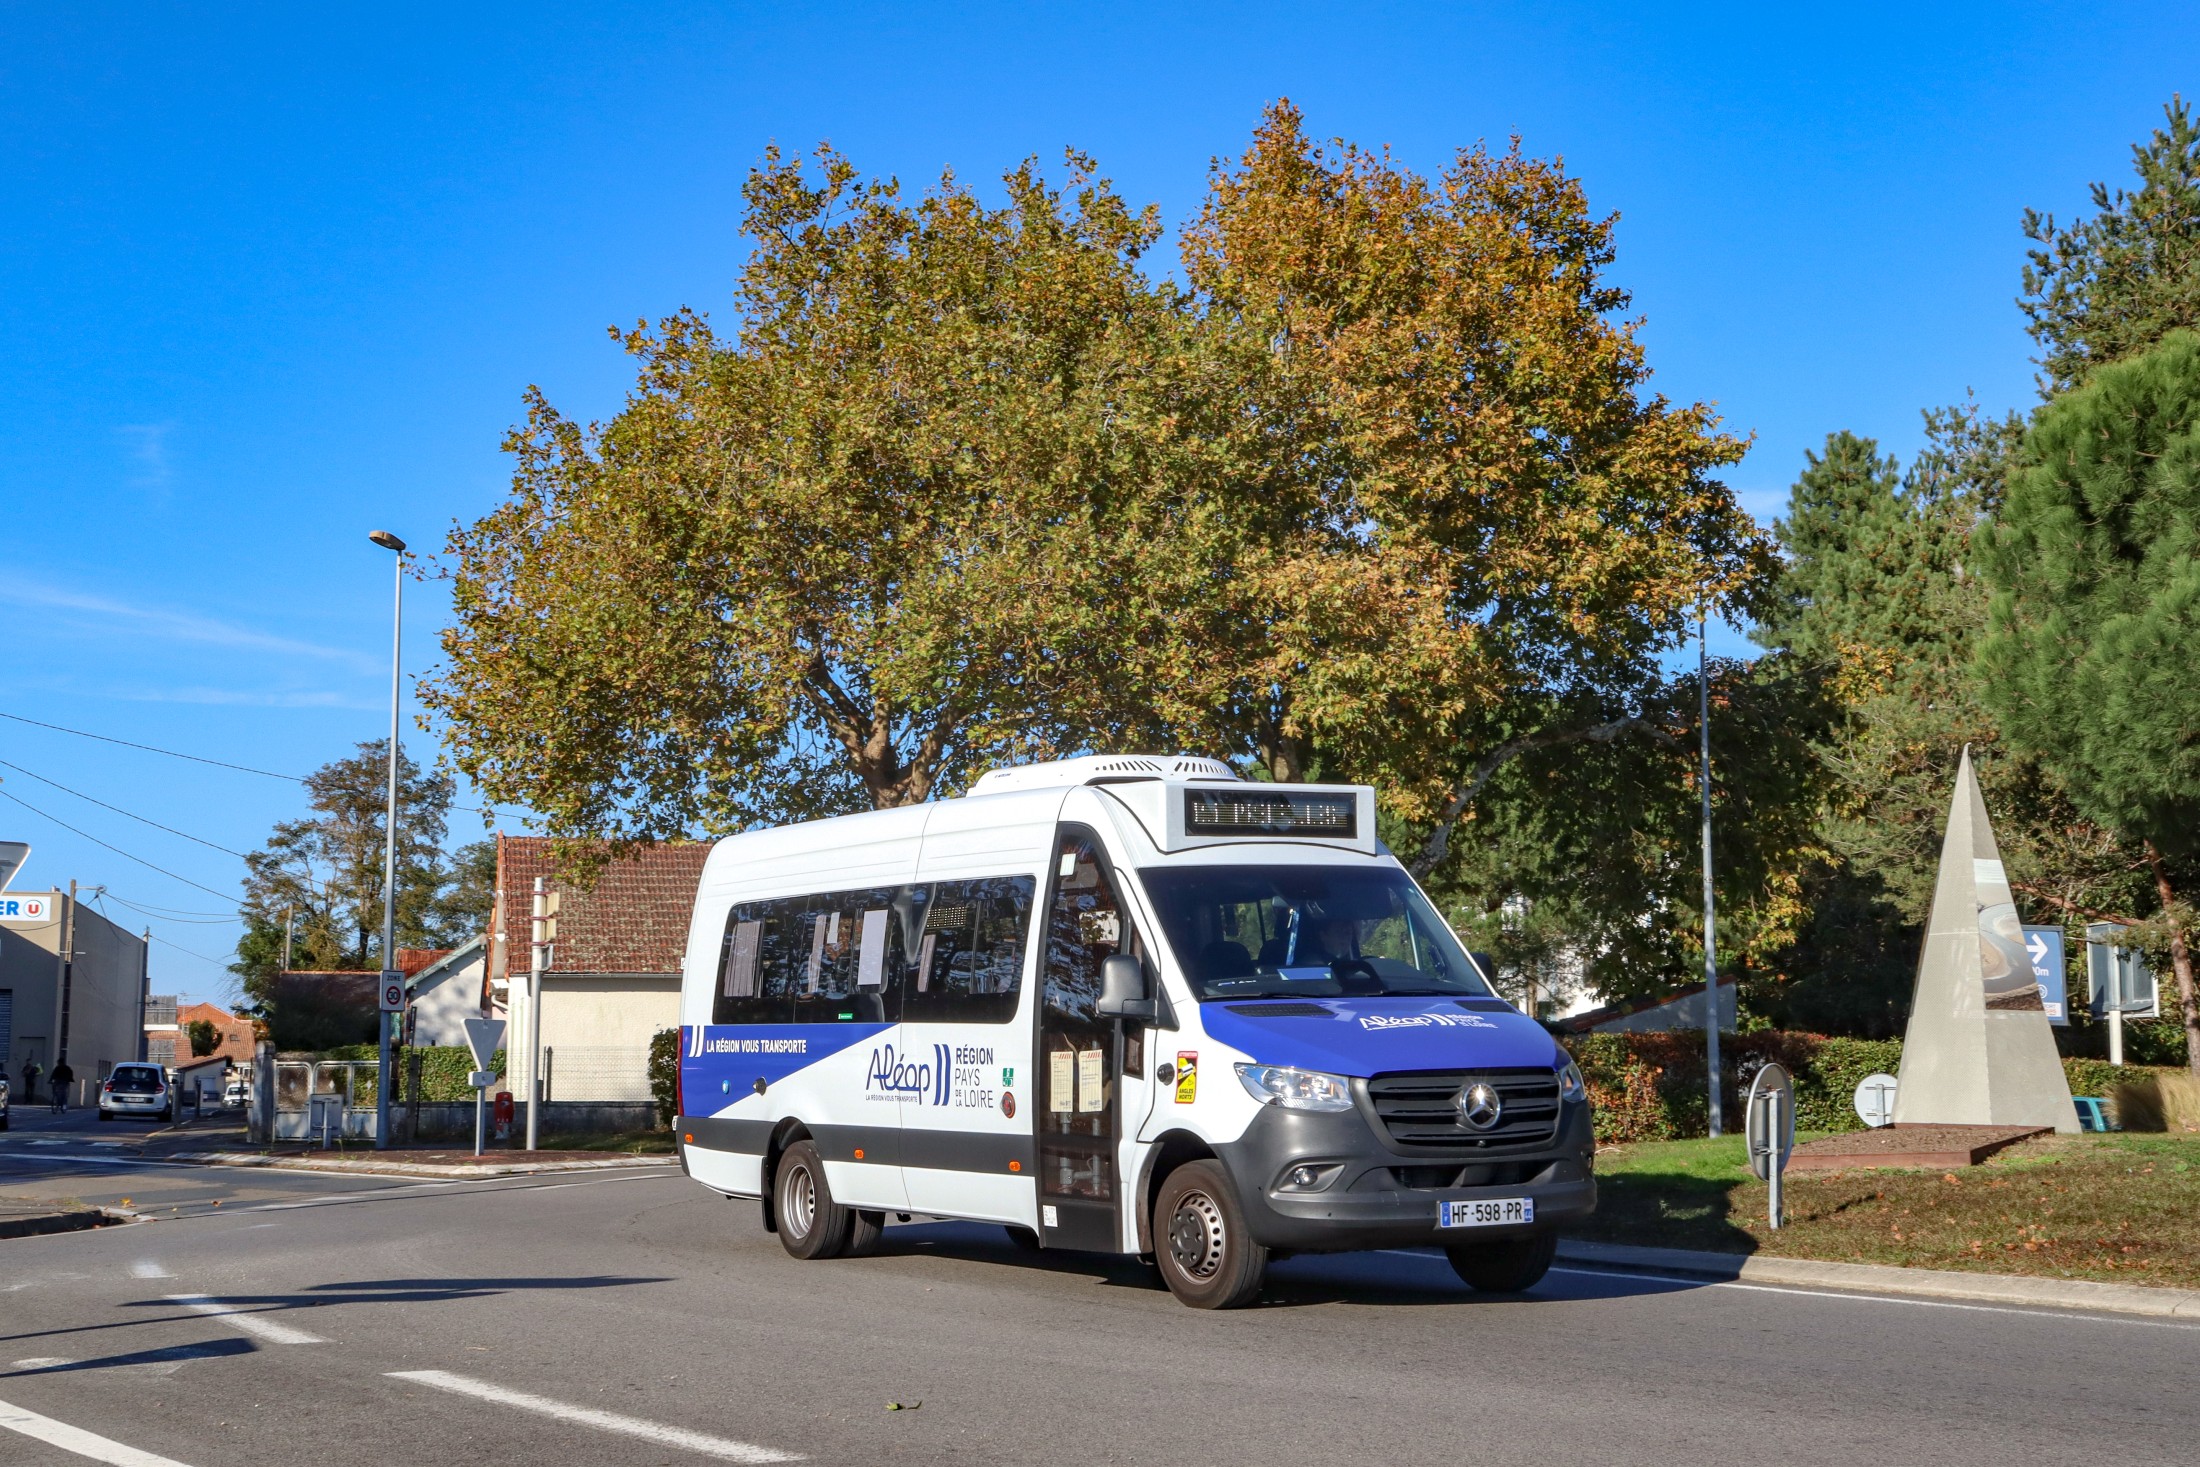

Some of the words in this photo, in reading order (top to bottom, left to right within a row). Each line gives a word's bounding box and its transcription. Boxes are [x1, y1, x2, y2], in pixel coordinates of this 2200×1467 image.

[28, 904, 39, 915] U
[389, 991, 399, 1000] 30
[706, 1040, 715, 1053] LA
[716, 1038, 739, 1053] RÉGION
[741, 1040, 759, 1053] VOUS
[761, 1040, 806, 1053] TRANSPORTE
[956, 1044, 994, 1065] RÉGION
[866, 1044, 931, 1105] Aléop
[955, 1068, 980, 1087] PAYS
[956, 1089, 962, 1097] DE
[956, 1099, 962, 1107] LA
[964, 1089, 994, 1108] LOIRE
[1452, 1202, 1522, 1223] HF-598-PR
